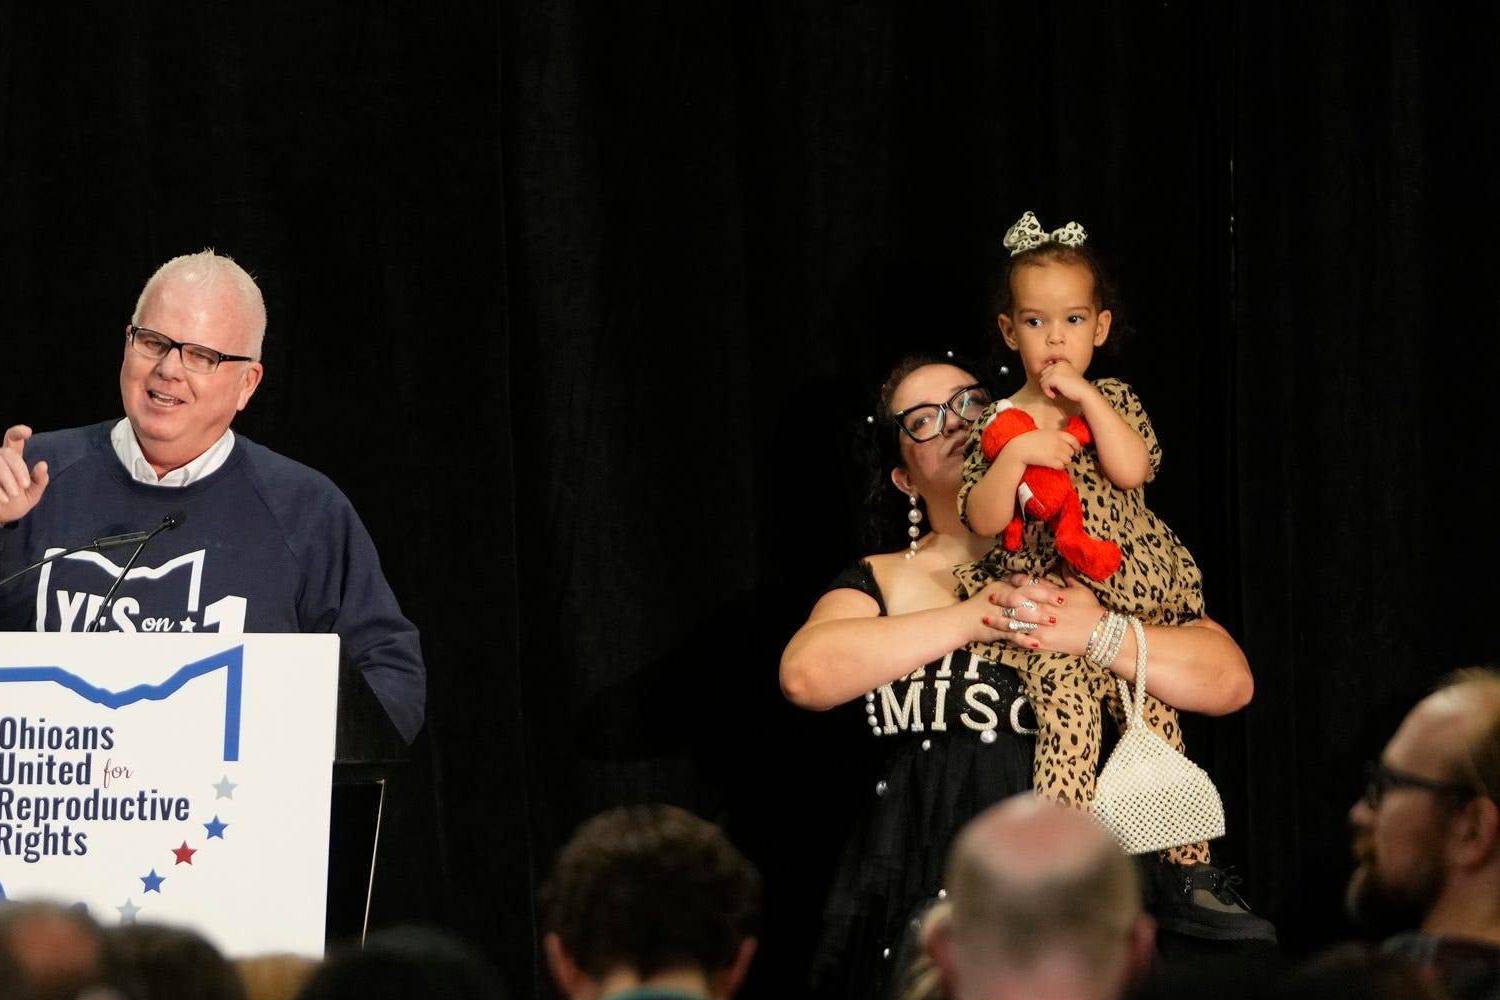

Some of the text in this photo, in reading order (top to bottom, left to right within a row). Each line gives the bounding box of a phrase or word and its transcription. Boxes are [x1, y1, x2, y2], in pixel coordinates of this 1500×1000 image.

[141, 617, 174, 632] on
[203, 595, 247, 633] 1
[0, 716, 114, 750] Ohioans
[103, 758, 133, 788] for
